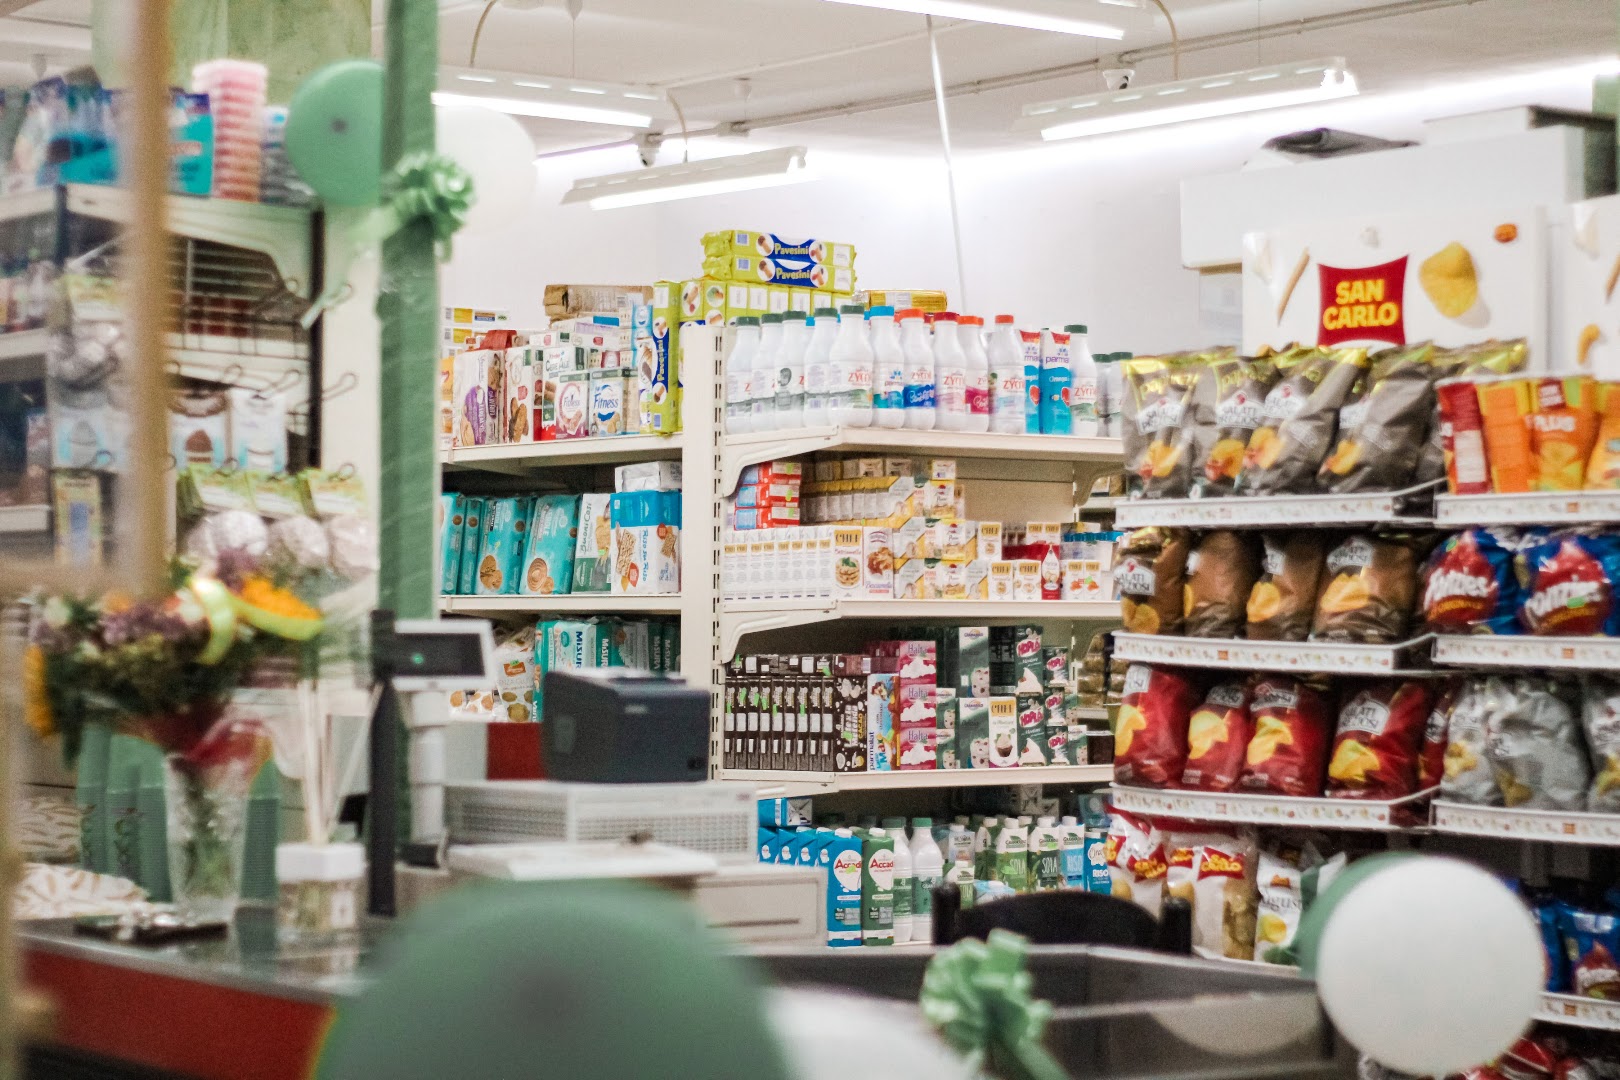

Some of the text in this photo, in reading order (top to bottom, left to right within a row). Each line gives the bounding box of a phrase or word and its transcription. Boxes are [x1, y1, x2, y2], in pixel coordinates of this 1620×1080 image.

[774, 243, 809, 258] Pavesini
[776, 267, 811, 280] Pavesini
[1335, 278, 1385, 304] SAN
[1322, 301, 1399, 330] CARLO
[656, 339, 665, 382] Pavesini
[593, 392, 619, 409] Fitness
[1092, 869, 1109, 878] RISO
